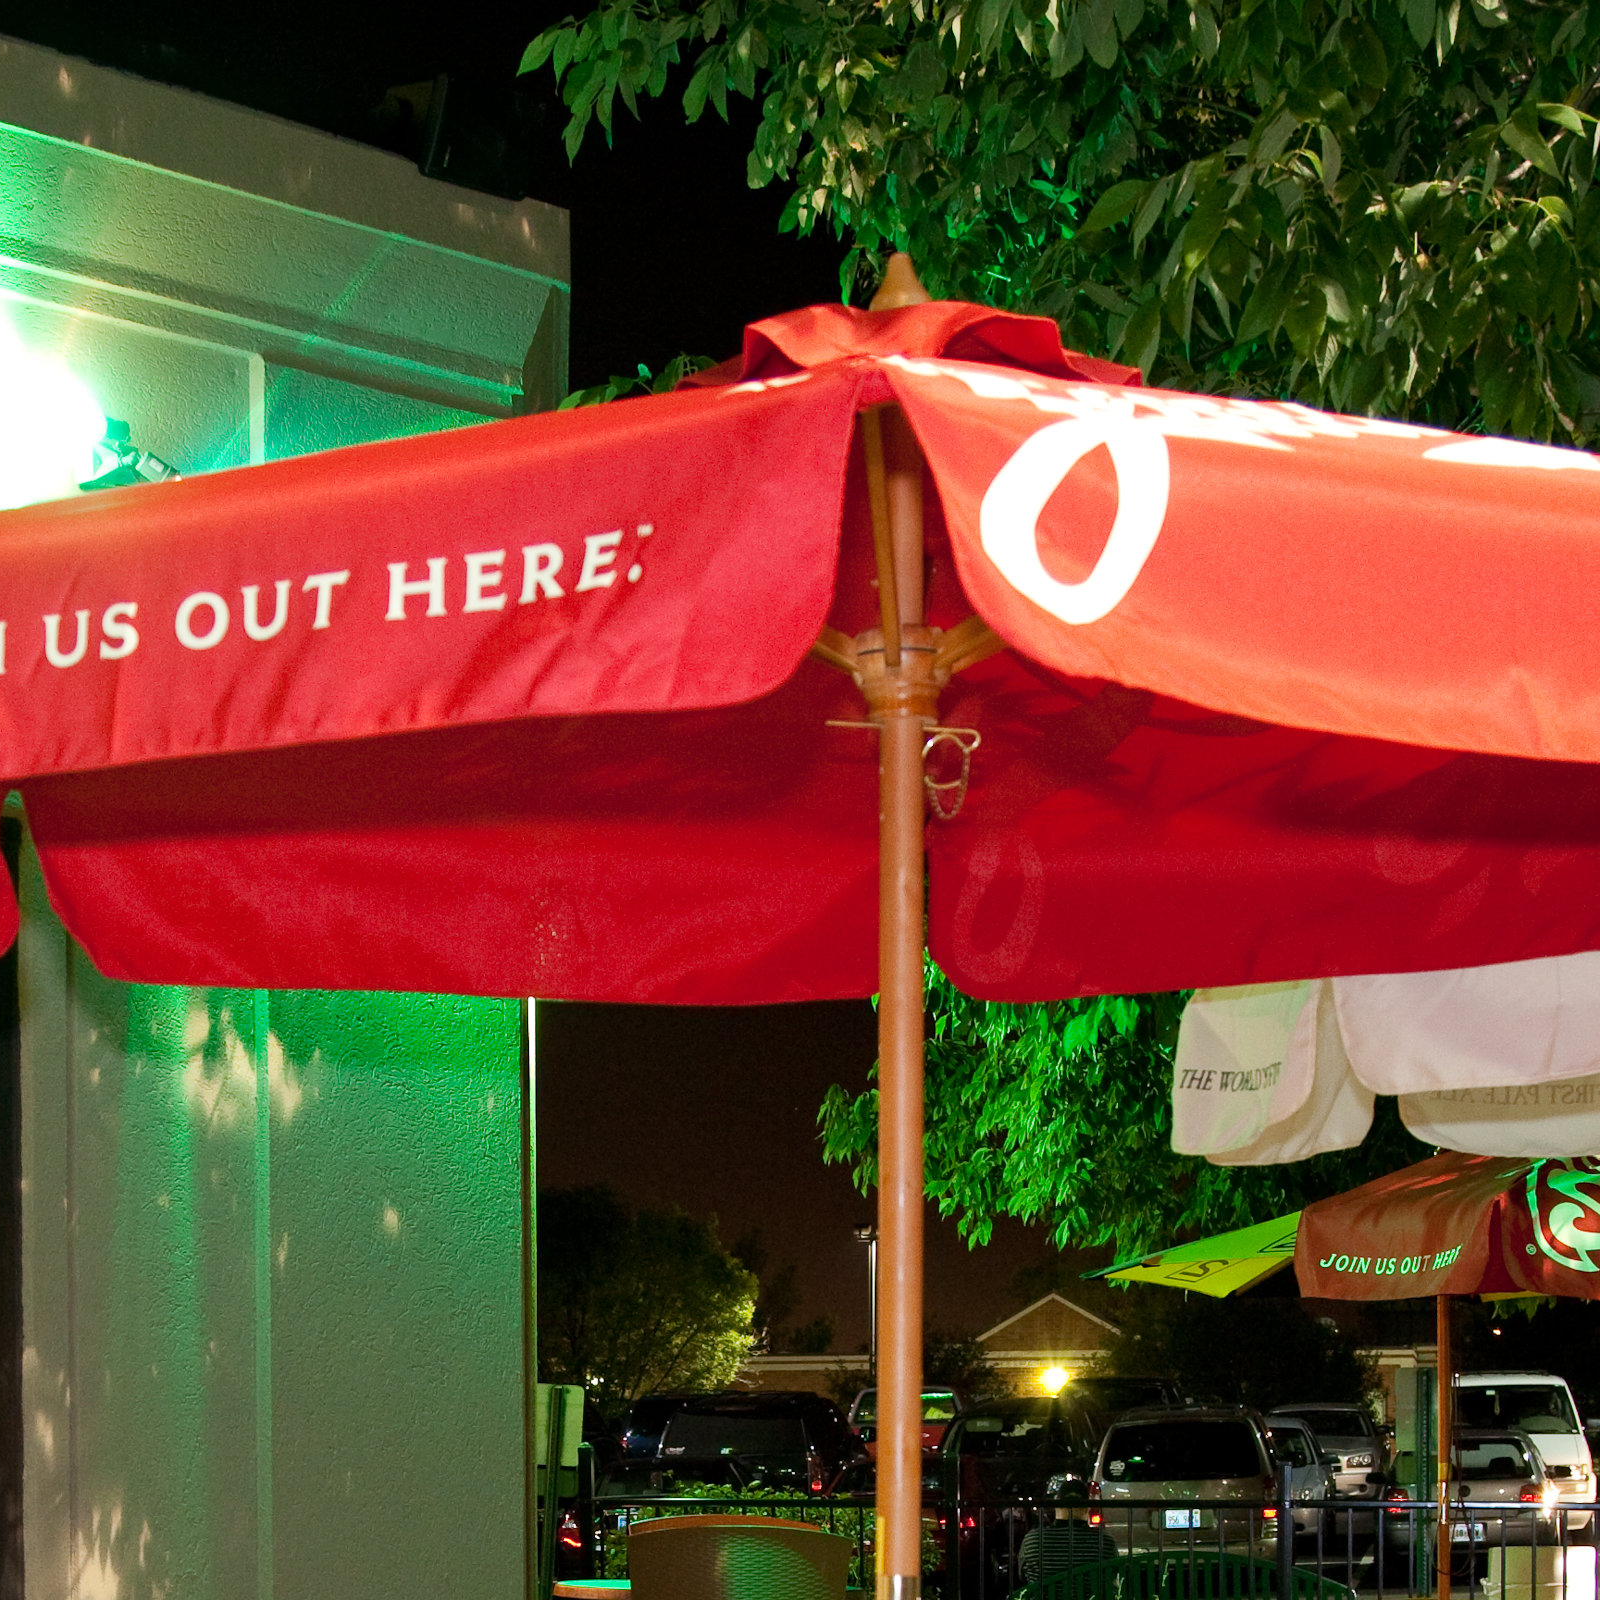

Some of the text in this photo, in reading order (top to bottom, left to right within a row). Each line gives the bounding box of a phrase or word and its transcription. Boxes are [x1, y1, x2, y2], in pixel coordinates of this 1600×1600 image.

[43, 608, 140, 669] US
[174, 569, 351, 651] OUT
[1179, 1068, 1217, 1091] THE
[1319, 1253, 1371, 1274] JOIN
[1375, 1257, 1397, 1275] US
[1400, 1254, 1431, 1275] OUT
